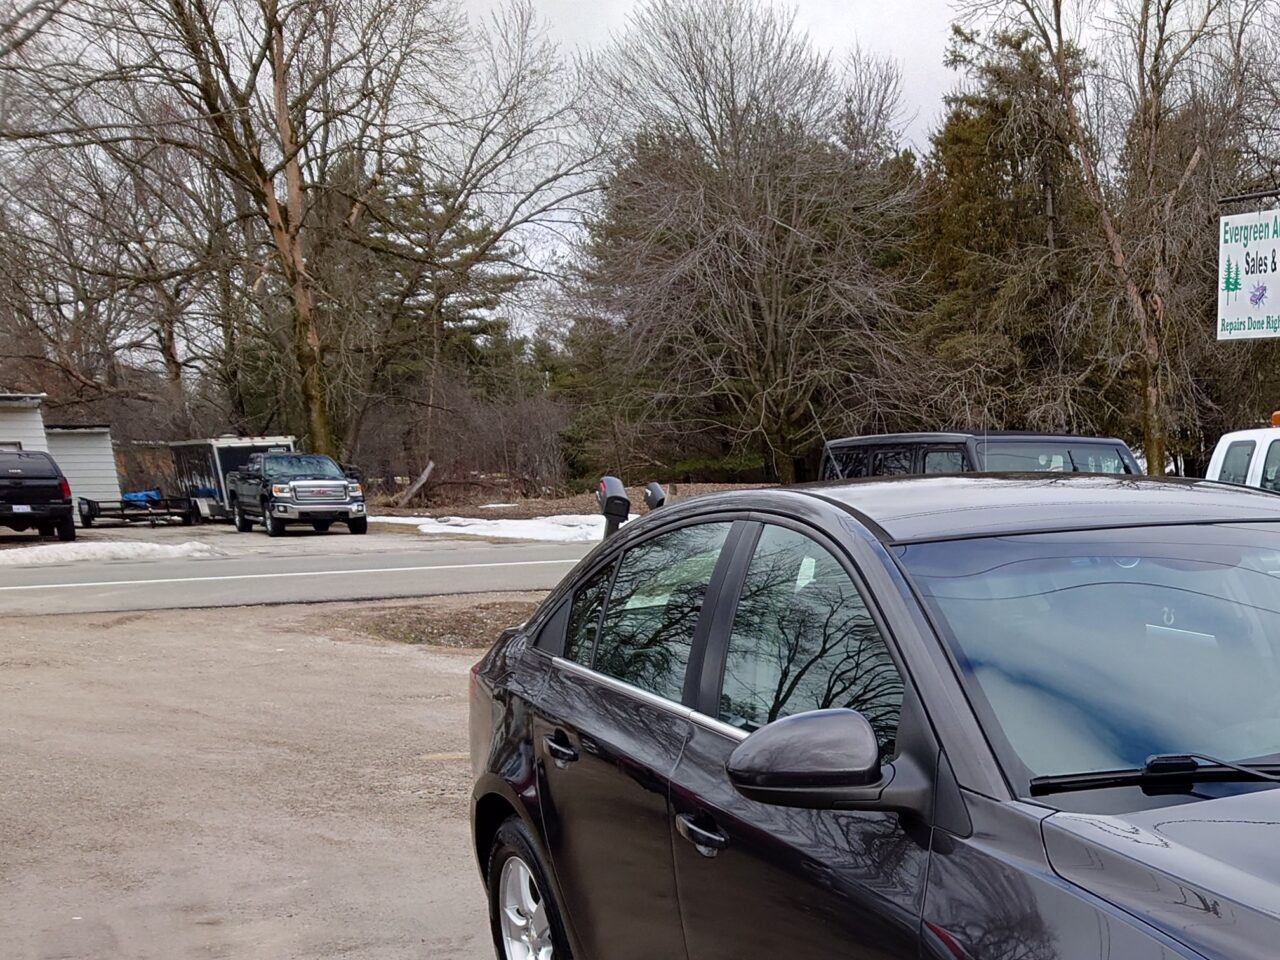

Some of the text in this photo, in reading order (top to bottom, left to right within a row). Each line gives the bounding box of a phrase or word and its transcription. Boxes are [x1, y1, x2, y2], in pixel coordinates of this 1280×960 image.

[1223, 222, 1269, 248] Evergreen
[1245, 251, 1268, 275] Sales
[1271, 248, 1277, 273] &
[1221, 318, 1246, 335] Repairs
[1247, 316, 1265, 330] Done
